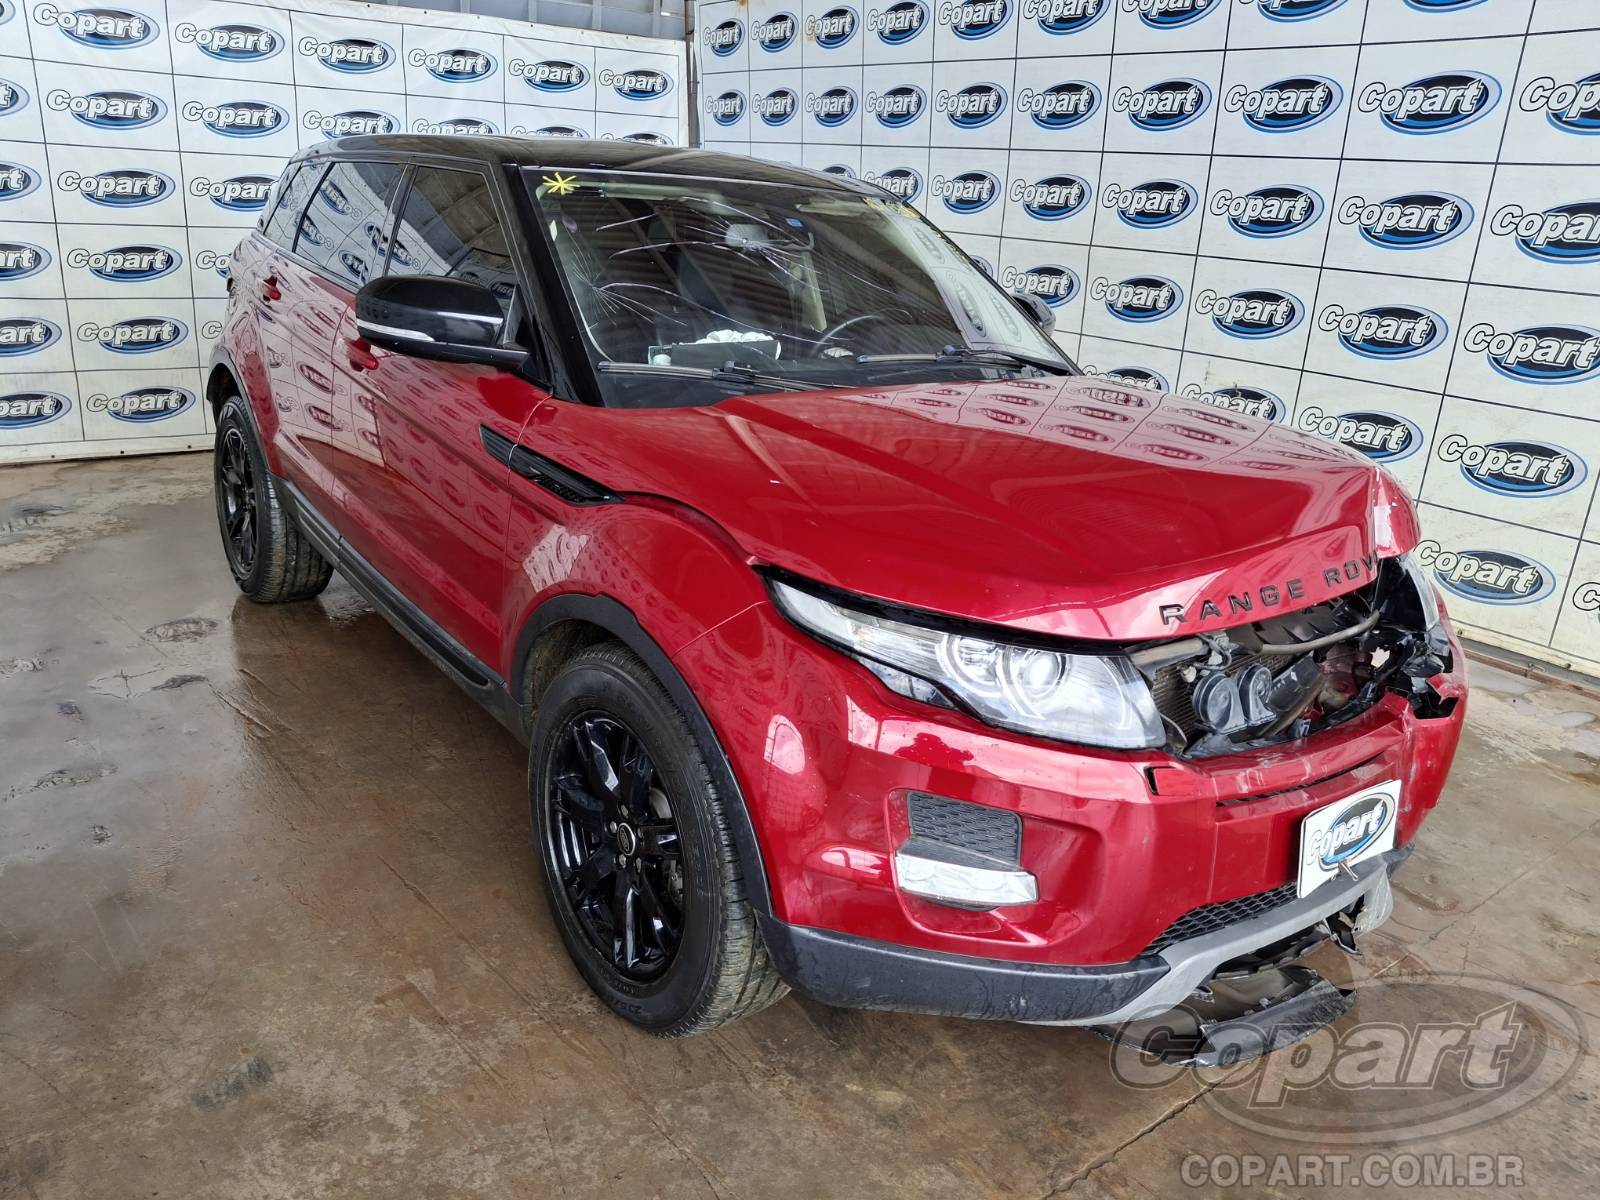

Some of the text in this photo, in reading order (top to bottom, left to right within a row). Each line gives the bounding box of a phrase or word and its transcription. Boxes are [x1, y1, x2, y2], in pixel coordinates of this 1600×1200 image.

[33, 3, 145, 39] Copart
[751, 16, 793, 42] Copart
[806, 11, 853, 39] Copart
[867, 4, 920, 36] Copart
[939, 0, 1002, 29] Copart
[175, 23, 271, 52] Copart
[703, 22, 741, 46] Copart
[299, 37, 386, 64] Copart
[409, 48, 489, 73] Copart
[509, 58, 582, 82] Copart
[599, 69, 667, 92] Copart
[46, 89, 154, 119] Copart
[705, 91, 743, 115] Copart
[752, 90, 793, 114] Copart
[806, 91, 852, 114] Copart
[865, 90, 919, 116] Copart
[935, 90, 999, 117] Copart
[1017, 87, 1091, 118] Copart
[1113, 84, 1199, 119] Copart
[1225, 83, 1329, 120] Copart
[1358, 79, 1484, 120] Copart
[1519, 76, 1600, 120] Cop
[182, 101, 276, 128] Copart
[303, 110, 391, 135] Copart
[58, 171, 162, 197] Copart
[931, 175, 993, 202] Copart
[1010, 179, 1083, 206] Copart
[1103, 184, 1187, 214] Copart
[1210, 189, 1313, 224] Copart
[1338, 195, 1457, 236] Copart
[1491, 204, 1600, 247] Copa
[67, 248, 170, 273] Copart
[1001, 266, 1072, 297] Copart
[1091, 277, 1173, 310] Copart
[1195, 289, 1292, 326] Copart
[77, 320, 178, 347] Copart
[1318, 304, 1431, 346] Copart
[1463, 323, 1600, 369] Copart
[86, 391, 184, 413] Copart
[1298, 406, 1408, 451] Copart
[1438, 434, 1569, 485] Copart
[1413, 539, 1538, 596] Copart
[1159, 550, 1378, 625] RANGE ROV
[1306, 799, 1385, 866] Copart
